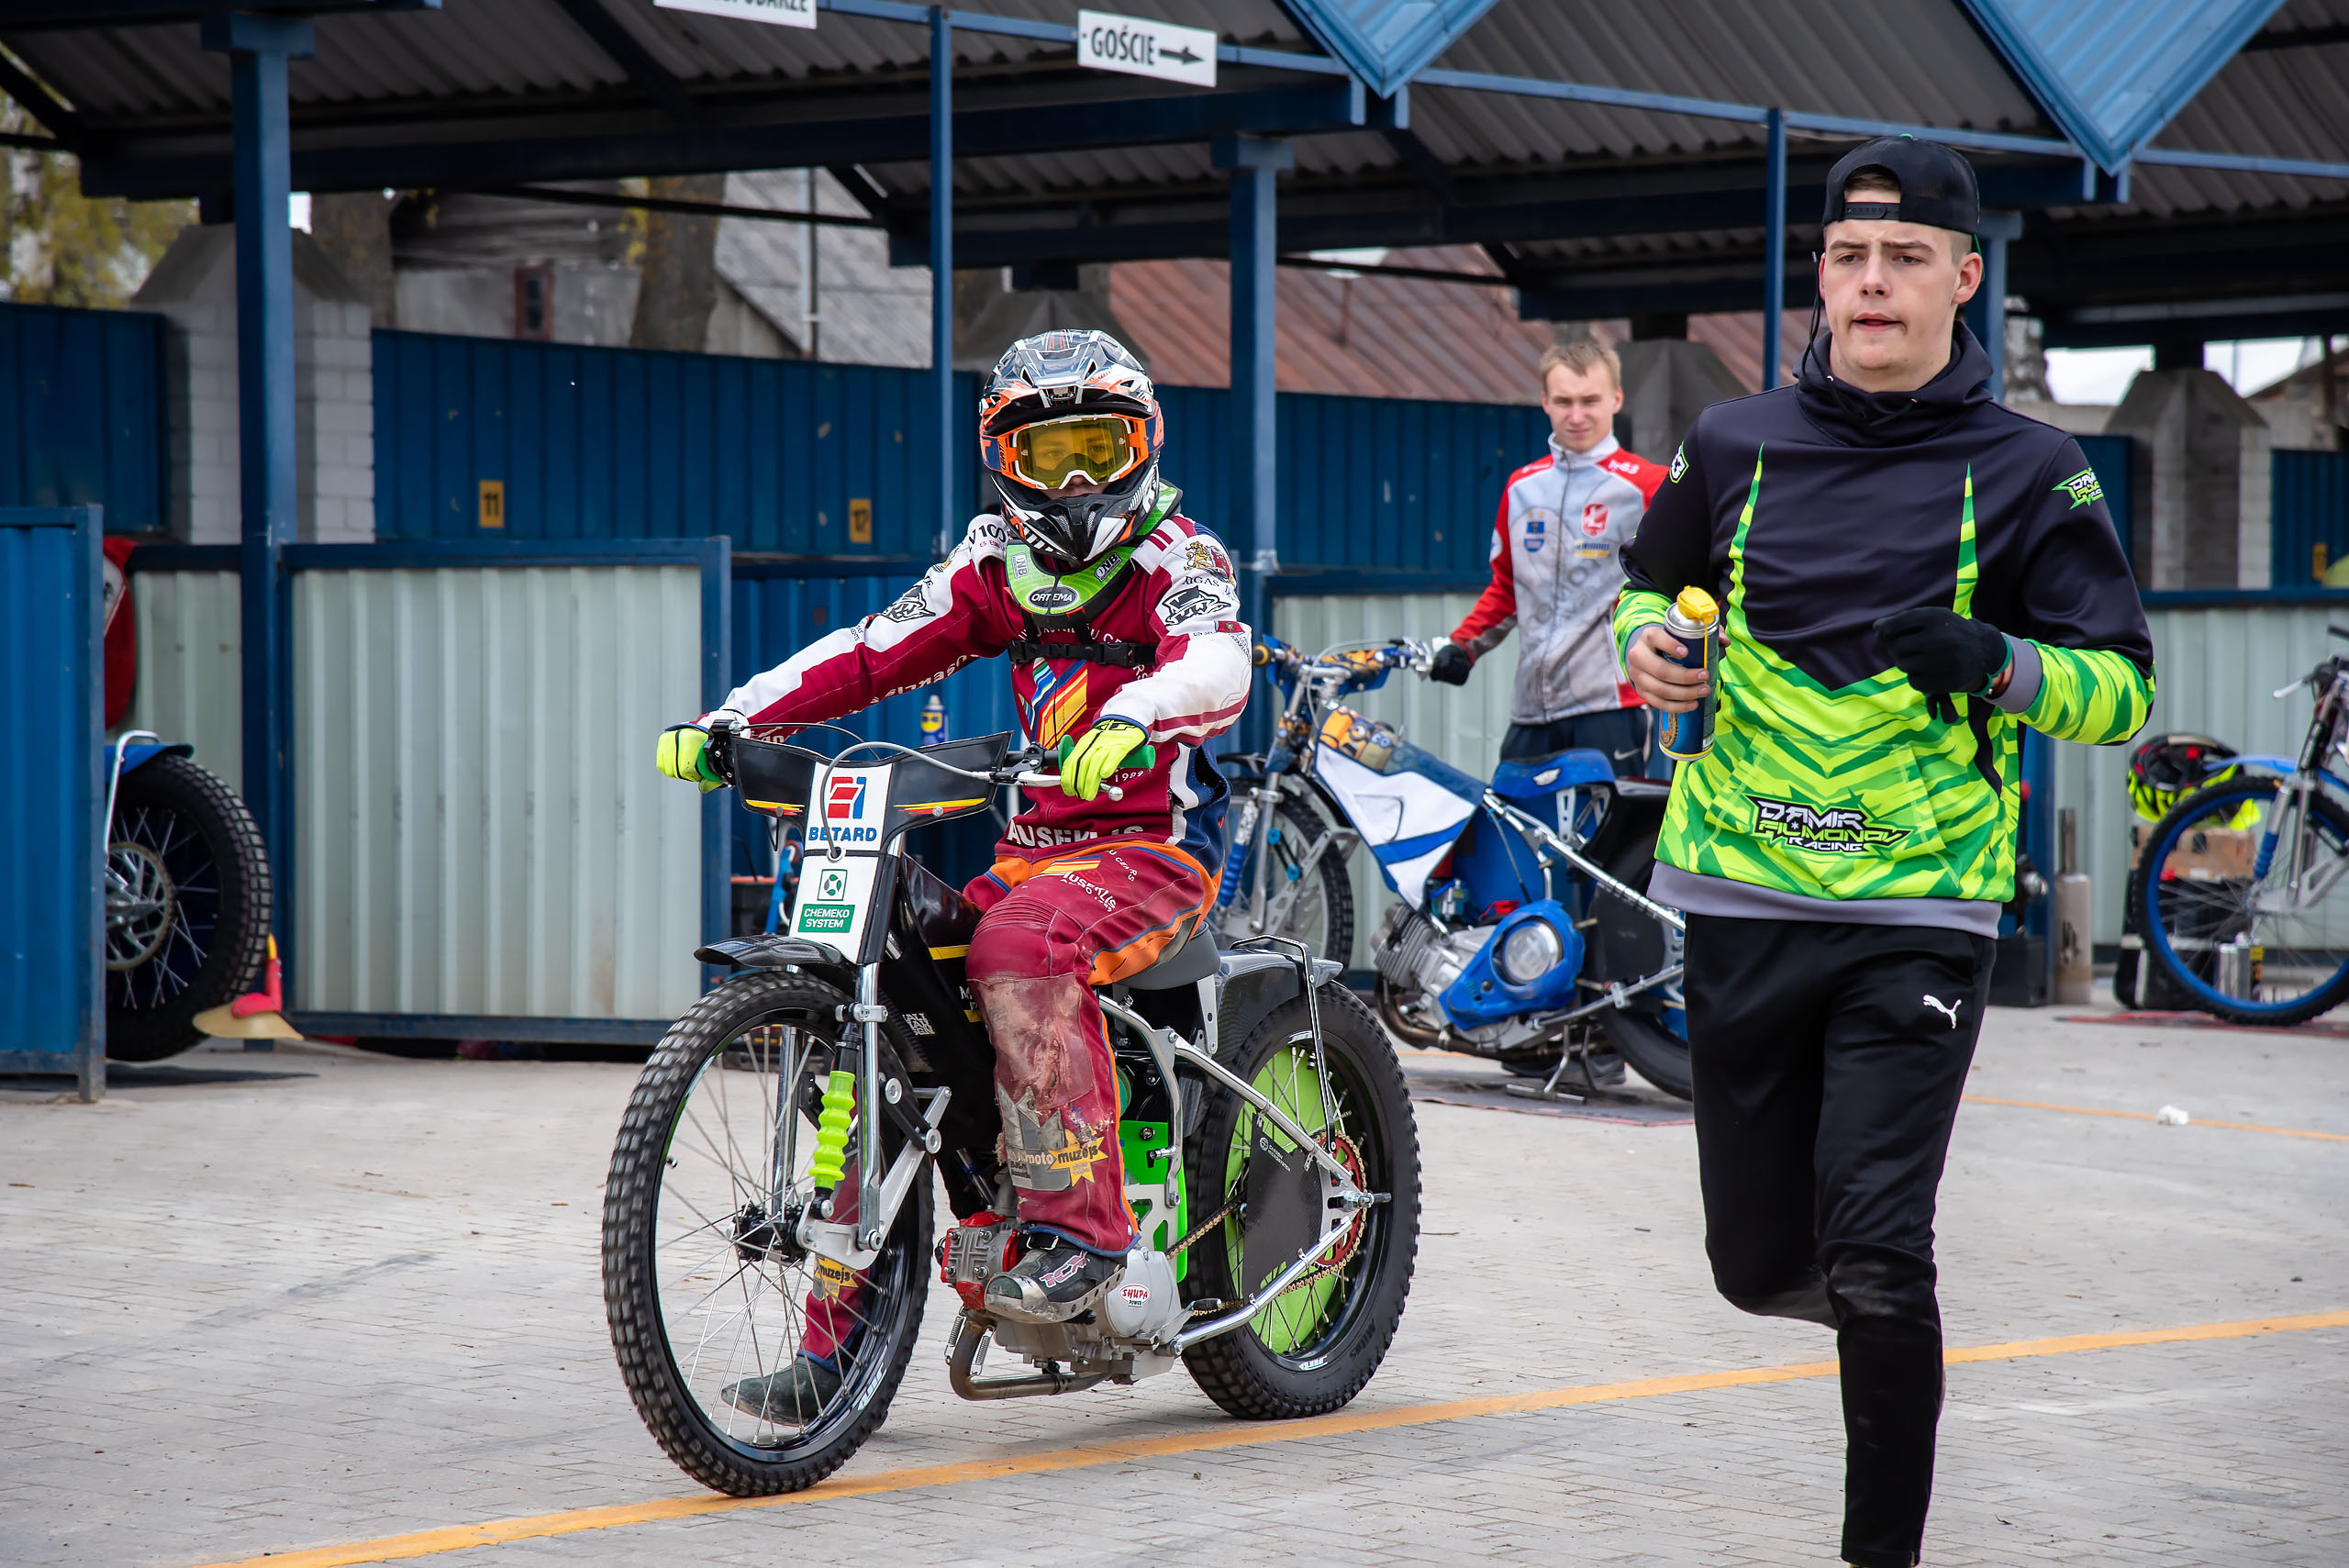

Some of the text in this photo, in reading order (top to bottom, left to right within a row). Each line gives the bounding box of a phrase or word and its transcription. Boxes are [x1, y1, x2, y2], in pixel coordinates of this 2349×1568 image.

[1091, 24, 1154, 65] GOŚCIE
[1030, 593, 1073, 602] ORTEMA
[807, 827, 877, 841] BETARD
[1788, 836, 1864, 851] RACING
[804, 907, 851, 918] CHEMEKO
[805, 918, 844, 929] SYSTEM
[1121, 1288, 1148, 1300] SHUPA
